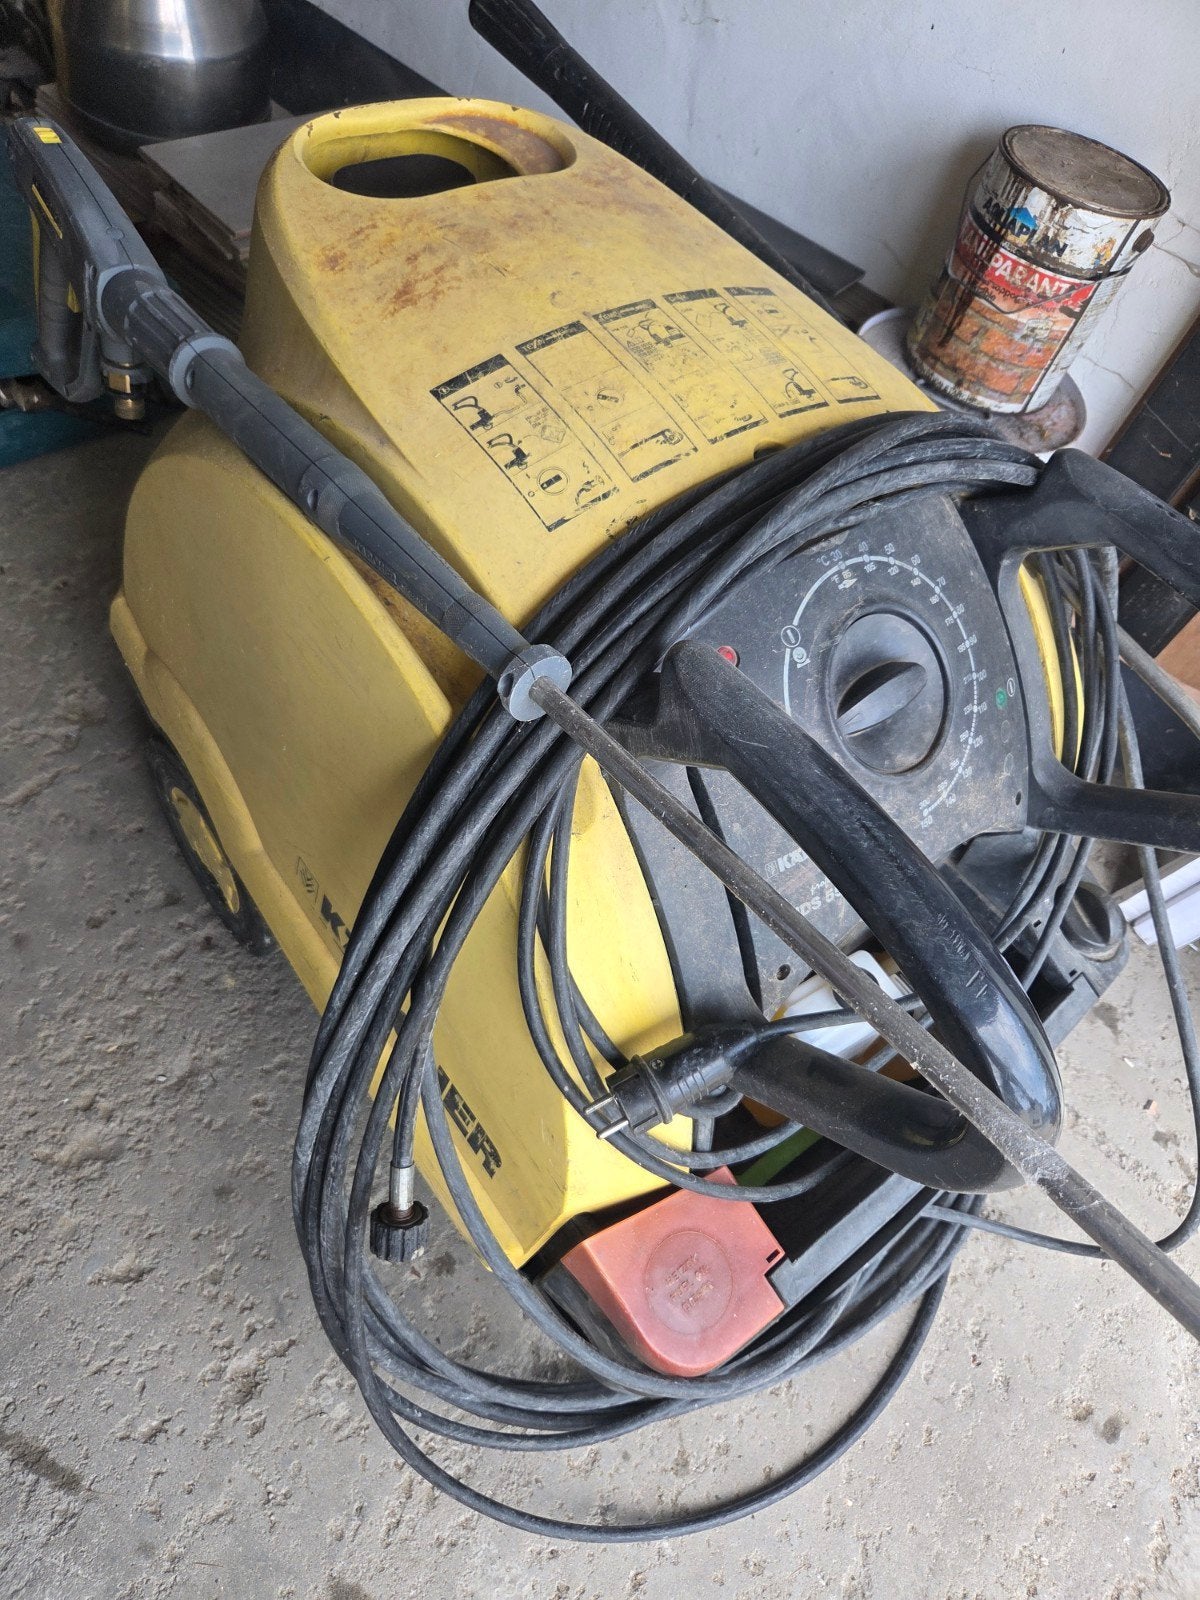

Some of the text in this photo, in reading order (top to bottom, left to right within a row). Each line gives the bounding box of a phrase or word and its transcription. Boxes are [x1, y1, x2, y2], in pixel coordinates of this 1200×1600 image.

[859, 541, 869, 552] 40
[884, 542, 895, 555] 50
[830, 548, 843, 561] 30
[911, 554, 921, 566] 60
[864, 562, 877, 573] 105
[888, 565, 899, 576] 120
[936, 576, 946, 588] 70
[921, 815, 933, 829] 150
